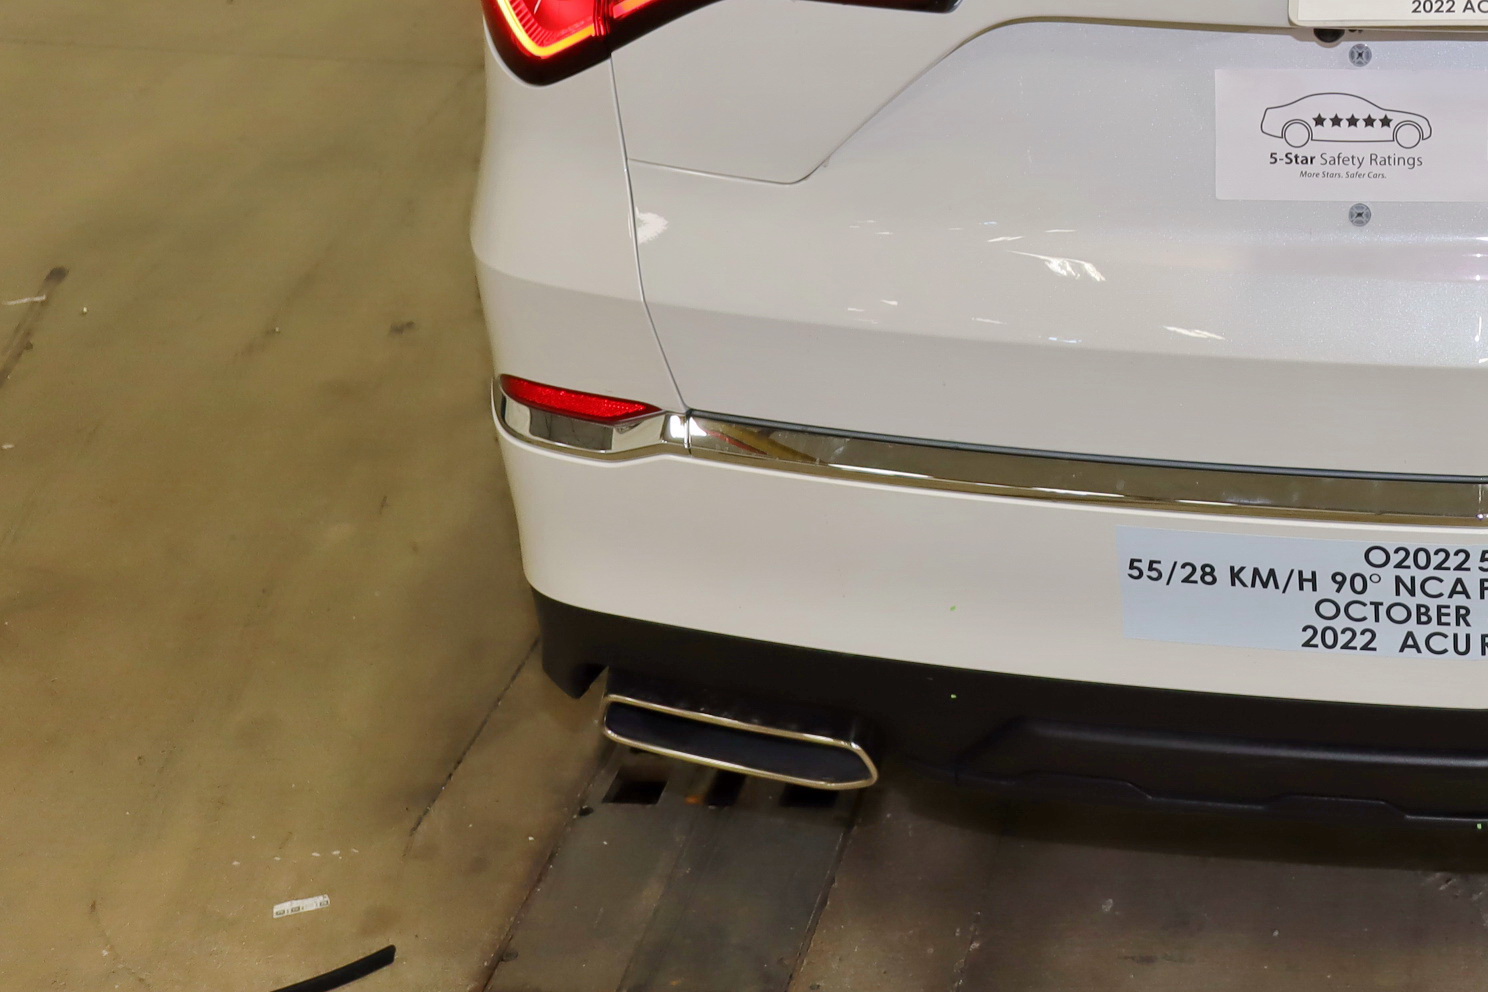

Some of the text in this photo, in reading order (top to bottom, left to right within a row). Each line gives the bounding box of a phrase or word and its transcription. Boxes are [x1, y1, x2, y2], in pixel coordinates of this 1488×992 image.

[1412, 0, 1455, 13] 2022
[1270, 152, 1422, 169] 5-Star Safety Ratings
[1300, 171, 1320, 179] More
[1322, 171, 1343, 179] Stars.
[1345, 171, 1366, 179] Safer
[1128, 558, 1217, 585] 55/28
[1230, 566, 1317, 593] KM/H
[1314, 598, 1471, 626] OCTOBER
[1302, 625, 1377, 651] 2022
